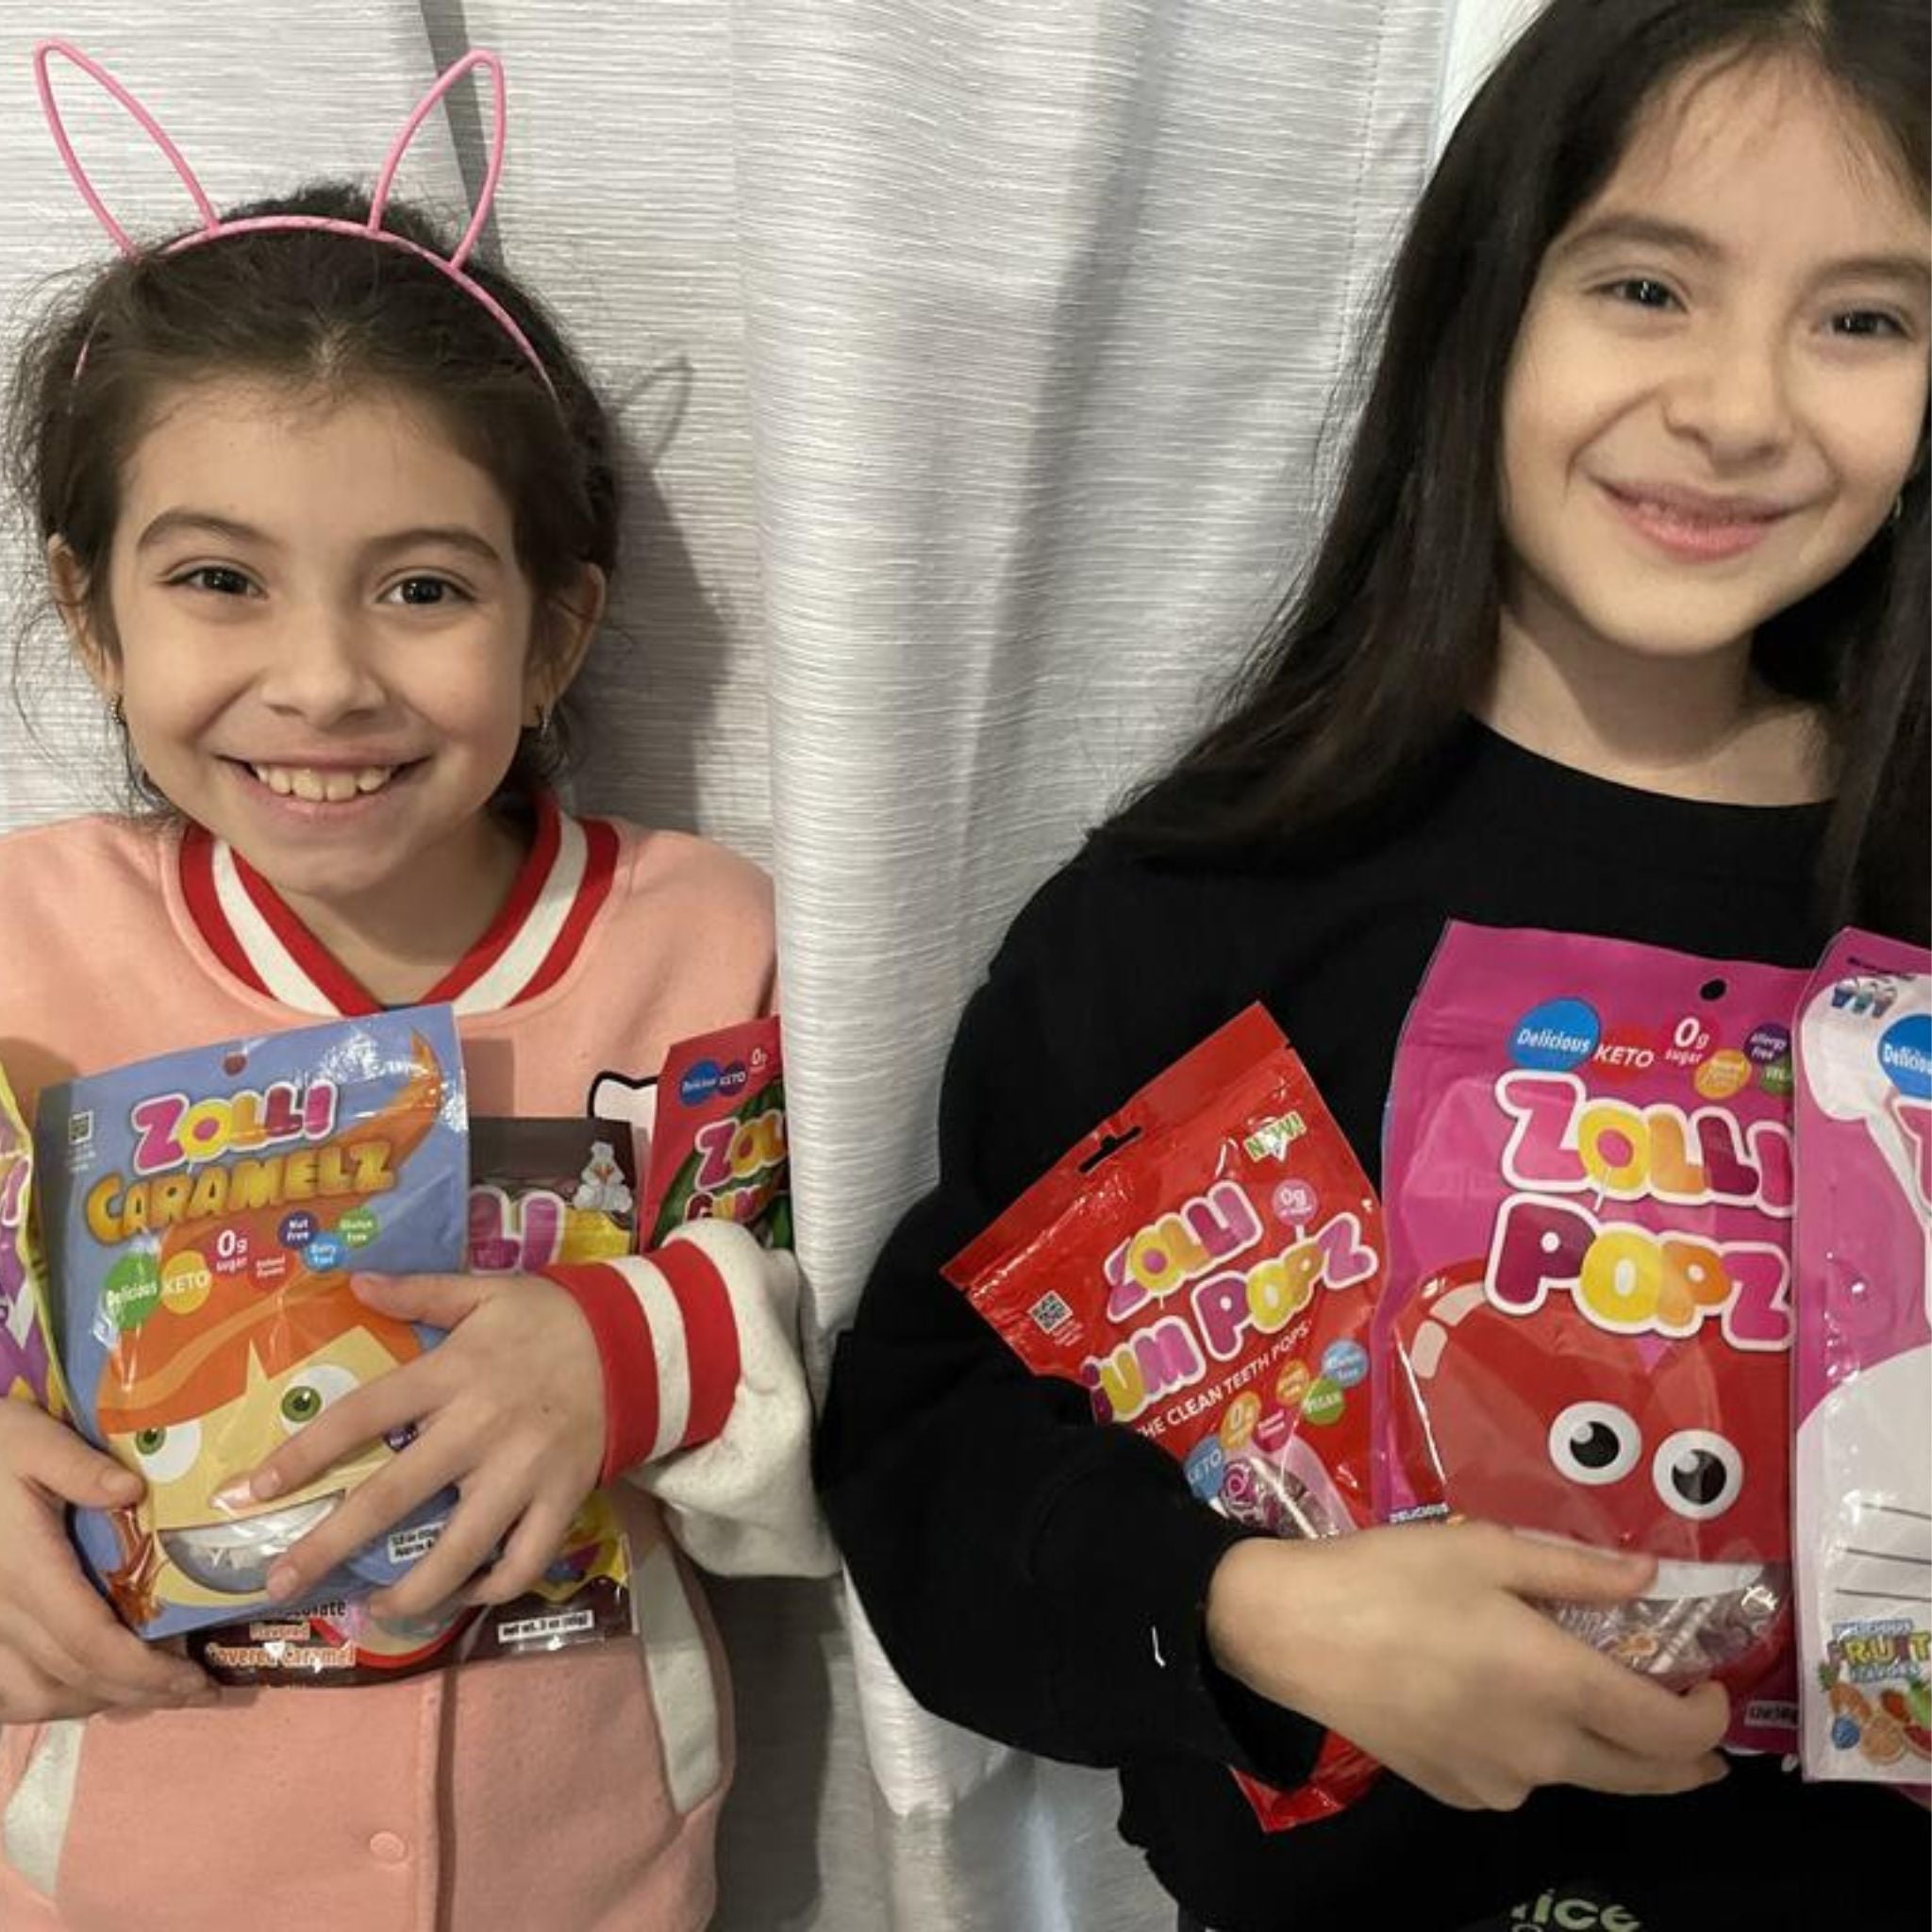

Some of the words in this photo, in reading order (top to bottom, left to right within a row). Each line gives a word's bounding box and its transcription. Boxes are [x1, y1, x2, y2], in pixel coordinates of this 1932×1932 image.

[1516, 1028, 1591, 1054] Delicious
[1593, 1043, 1655, 1068] KETO
[1663, 1048, 1703, 1066] sugar
[1674, 1016, 1710, 1049] 0g
[132, 1079, 339, 1175] ZOLLI
[1493, 1069, 1793, 1219] ZOLLI
[85, 1141, 399, 1247] CARAMELZ
[1280, 1188, 1307, 1211] 0g
[216, 1229, 249, 1257] 0g
[1103, 1179, 1264, 1323] ZOLLI
[161, 1270, 210, 1296] KETO
[1190, 1211, 1379, 1361] POPZ
[1484, 1191, 1794, 1352] POPZ
[1166, 1385, 1224, 1425] CLEAN
[1223, 1352, 1270, 1394] TEETH
